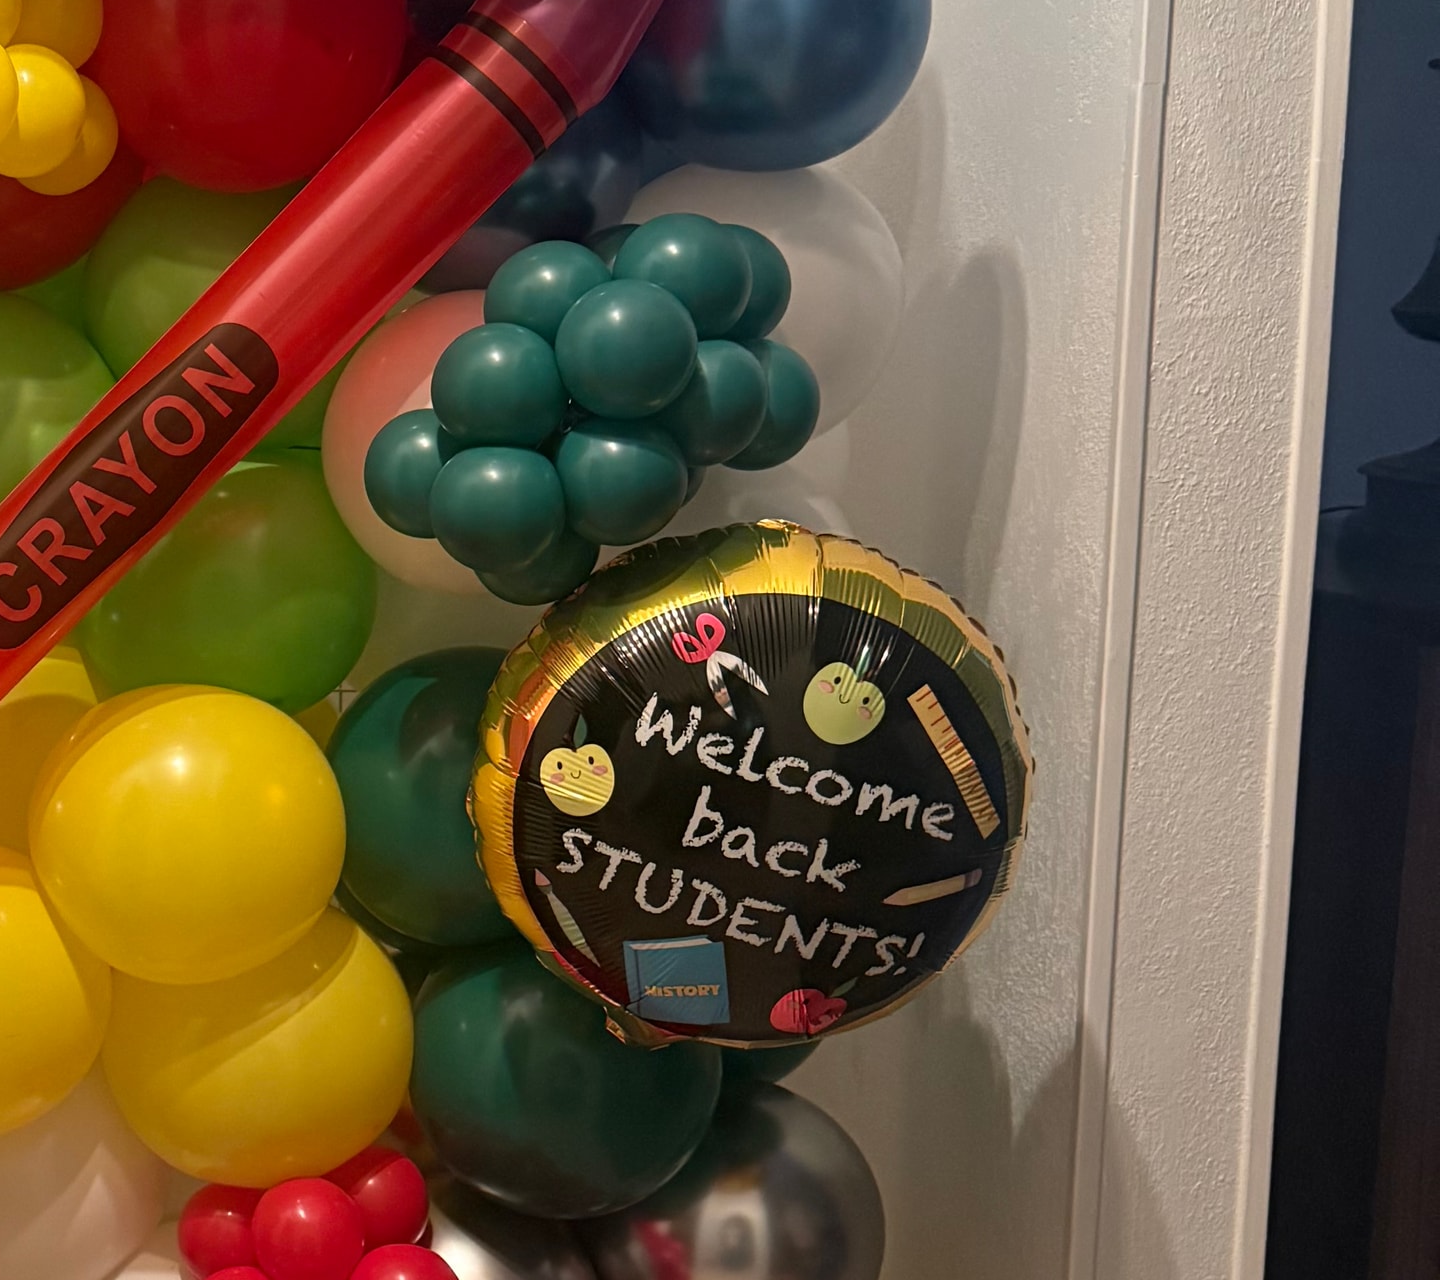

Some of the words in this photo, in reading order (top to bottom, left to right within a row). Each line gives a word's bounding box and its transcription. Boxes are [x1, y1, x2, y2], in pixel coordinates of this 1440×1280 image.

[634, 692, 956, 841] Welcome
[682, 785, 862, 892] back
[556, 827, 926, 977] STUDENTS!
